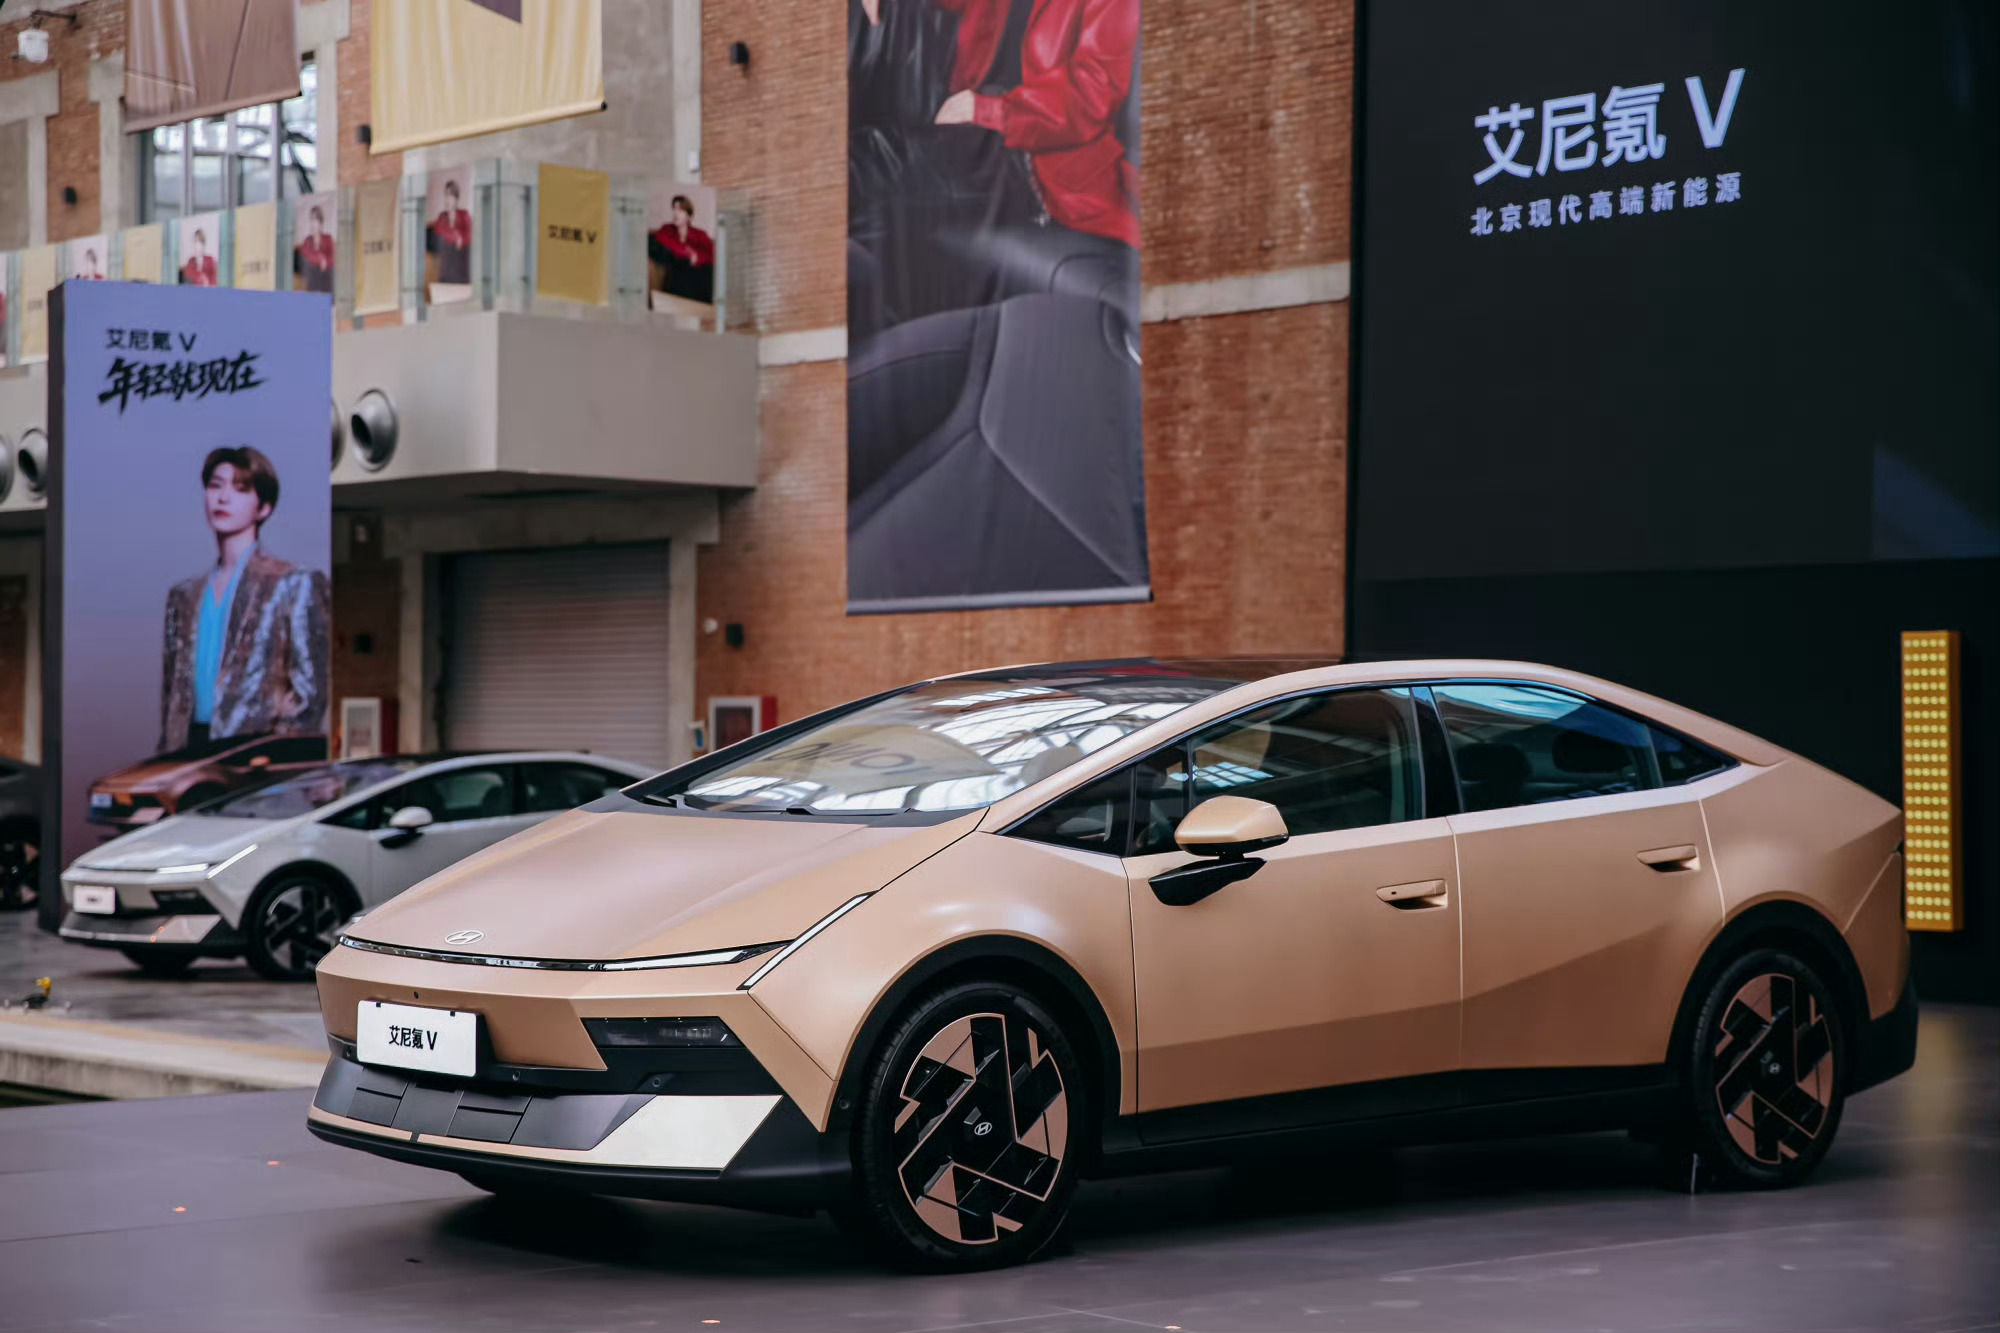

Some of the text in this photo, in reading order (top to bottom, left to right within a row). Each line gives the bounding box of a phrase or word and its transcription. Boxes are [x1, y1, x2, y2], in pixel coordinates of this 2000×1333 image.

[1473, 67, 1746, 186] 艾尼氪 V
[1469, 171, 1743, 237] 北京现代高端新能源
[106, 328, 197, 352] 艾尼氪 V
[97, 348, 268, 414] 年轻就现在
[388, 1024, 438, 1051] 艾尼氪 V
